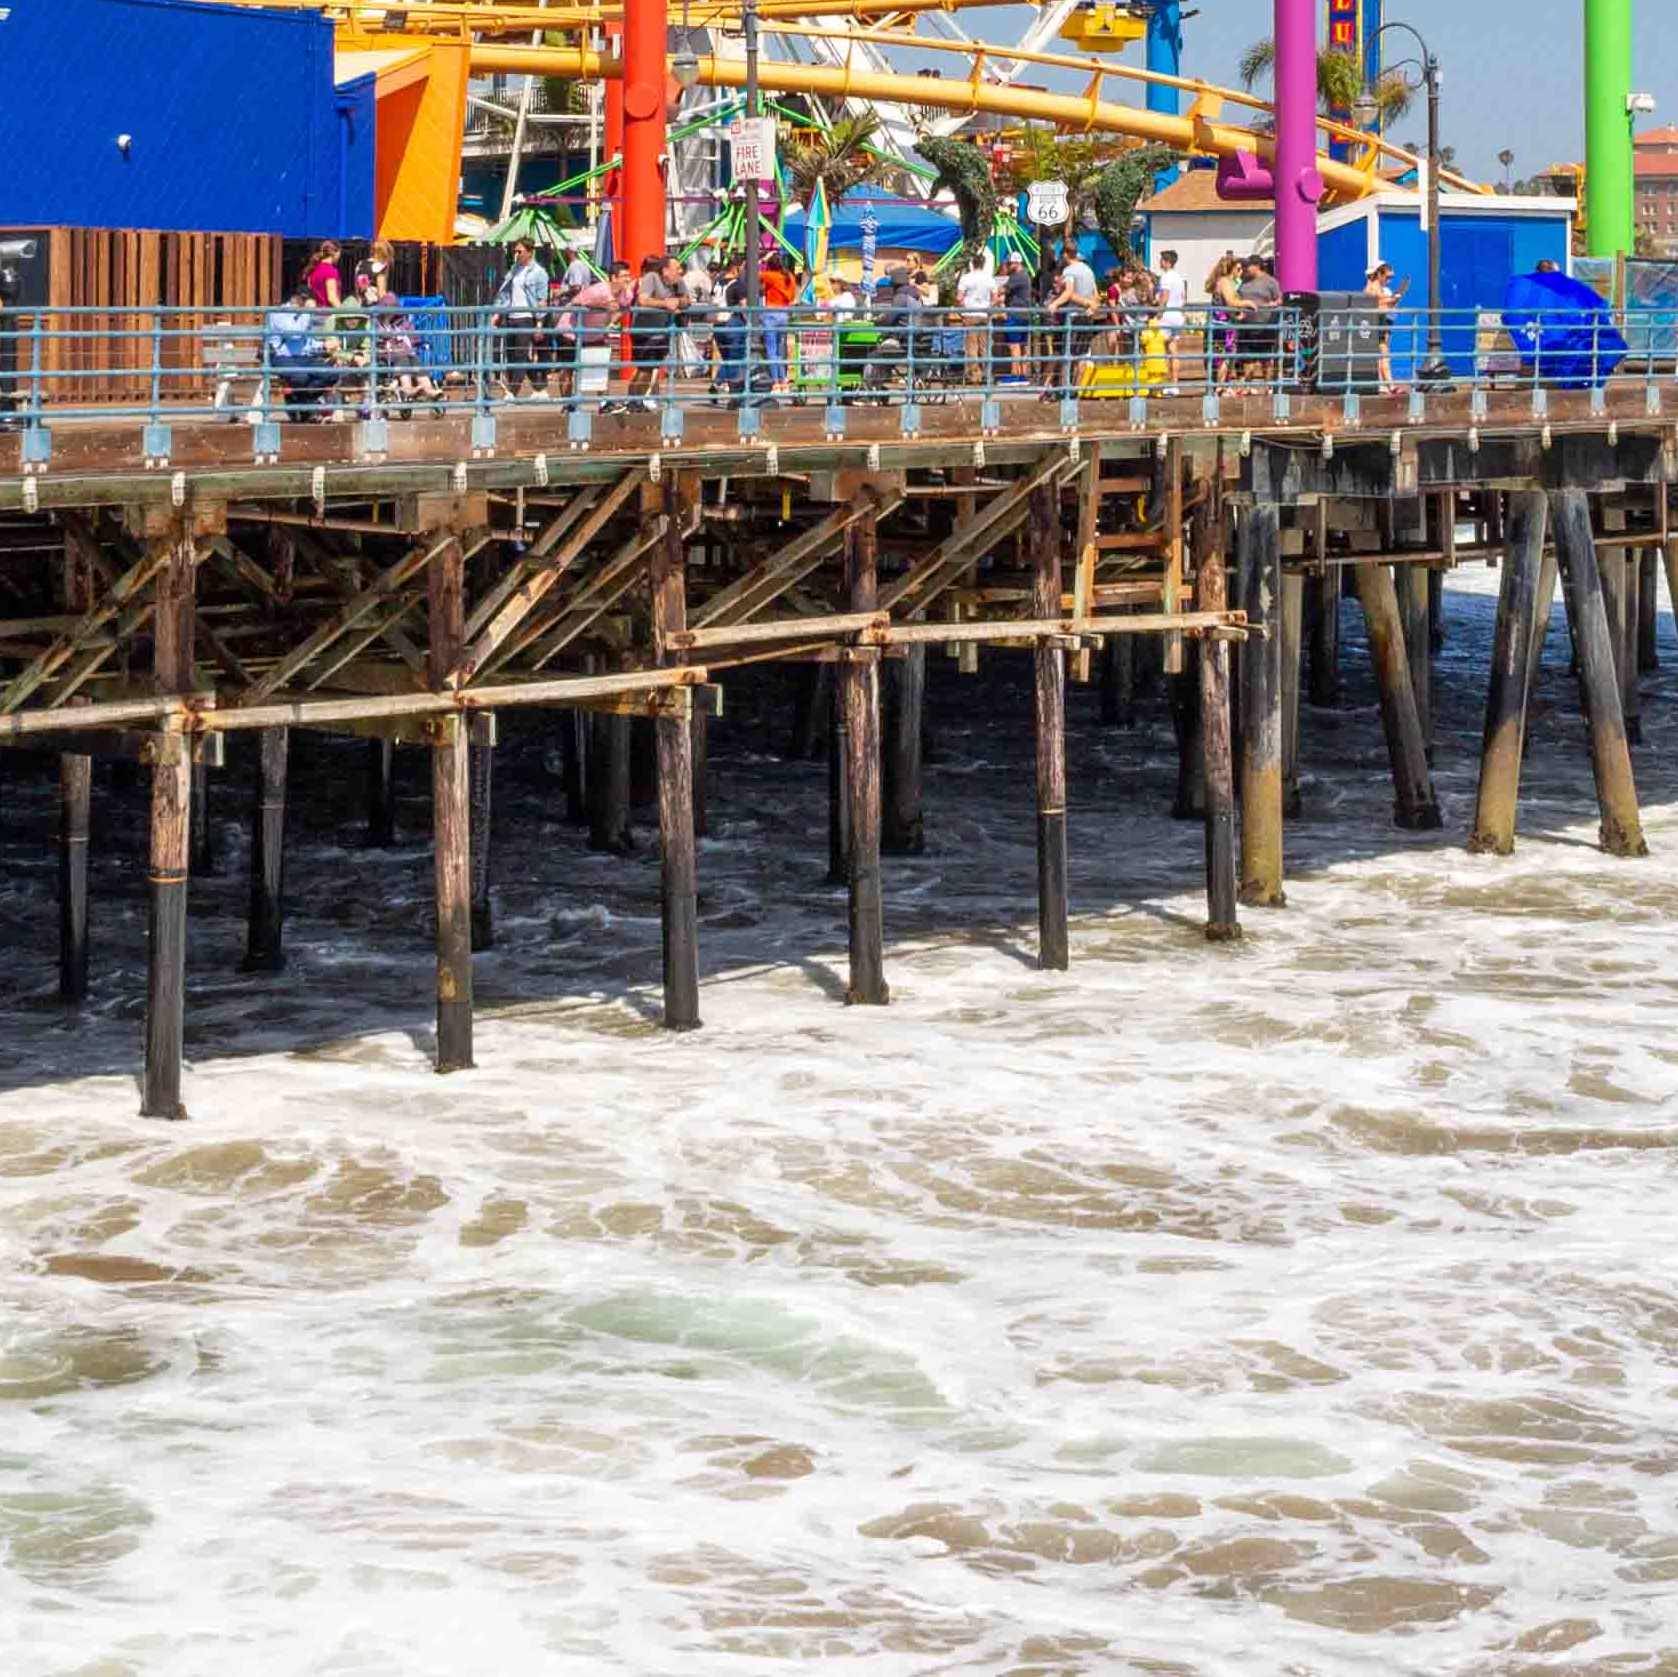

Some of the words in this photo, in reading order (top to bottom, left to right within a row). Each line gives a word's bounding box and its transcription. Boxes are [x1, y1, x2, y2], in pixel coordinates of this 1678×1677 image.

[736, 145, 761, 159] FIRE
[734, 161, 763, 177] LANE
[1038, 205, 1059, 220] 66
